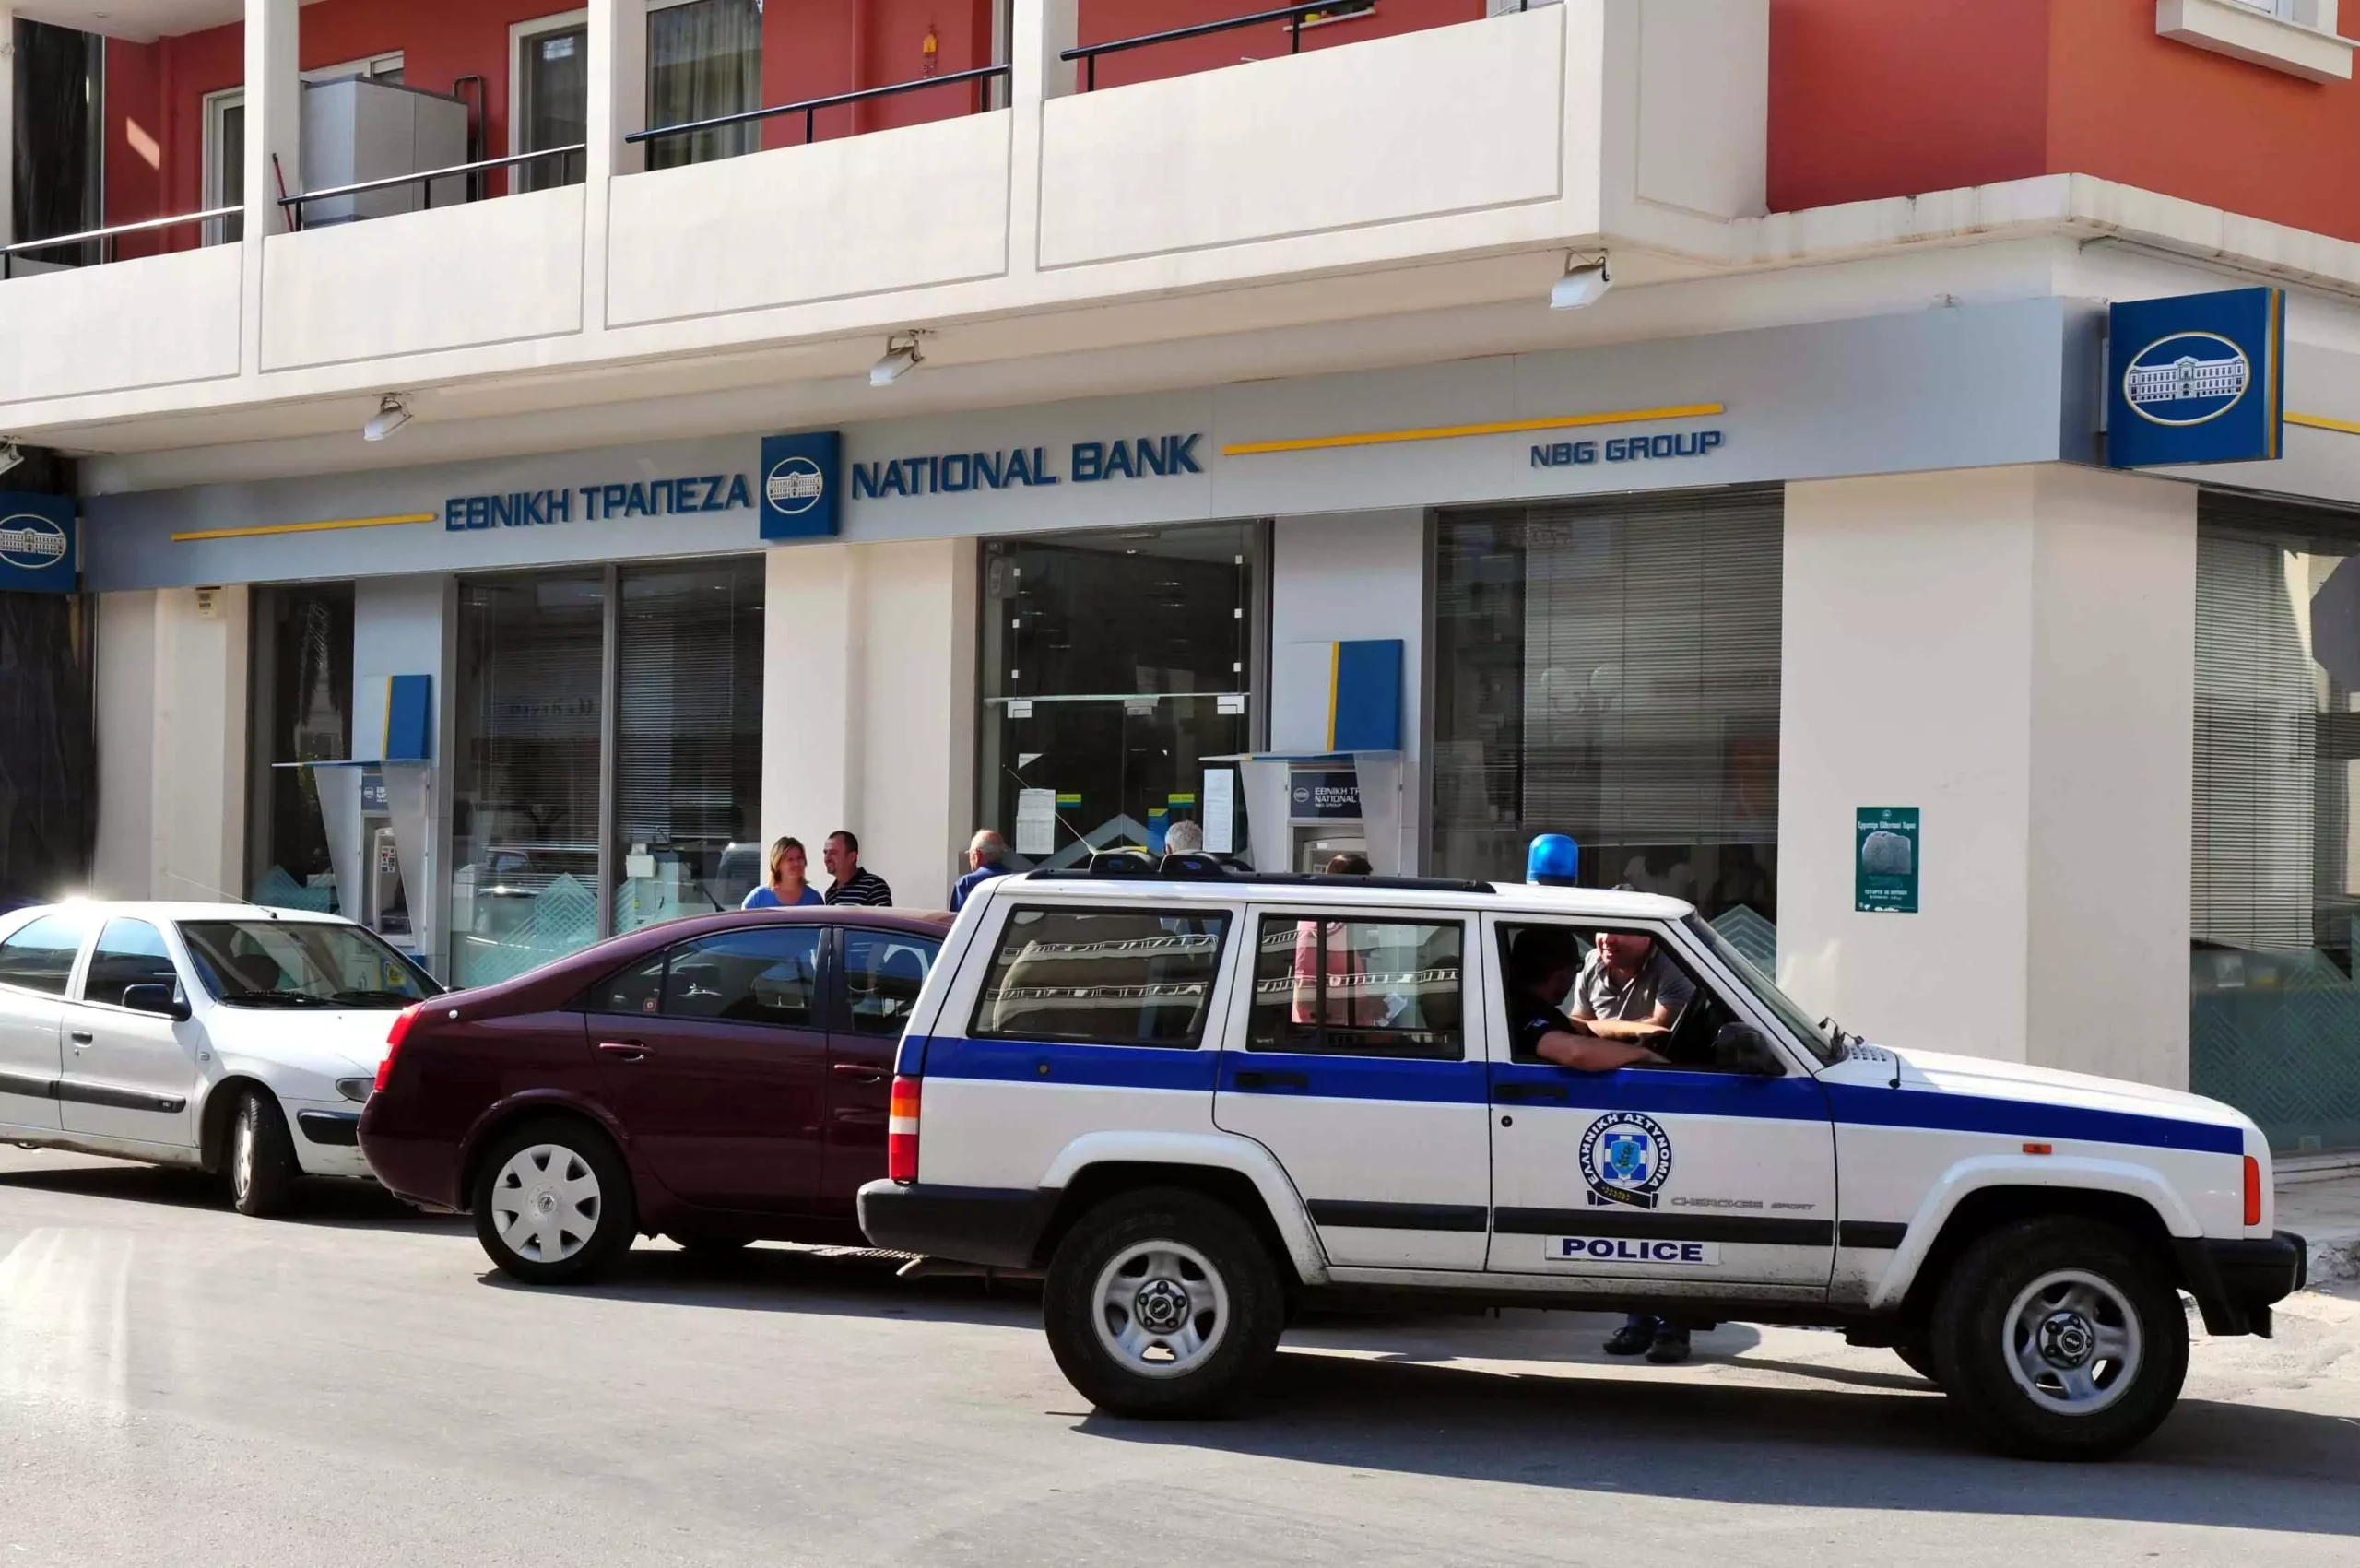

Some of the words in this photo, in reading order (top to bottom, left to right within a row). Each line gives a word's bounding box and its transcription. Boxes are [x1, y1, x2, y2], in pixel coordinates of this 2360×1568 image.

[851, 446, 1060, 501] NATIONAL
[1071, 432, 1203, 483] BANK
[1530, 441, 1596, 467] NBG
[1605, 430, 1722, 462] GROUP
[445, 488, 571, 532] ΕΘΝΙΚΗ
[579, 473, 753, 521] ΤΡΑΠΕΖΑ
[1581, 1114, 1619, 1185] ΕΛΛΗΝΙΚΗ
[1623, 1113, 1670, 1187] ΑΣΤΥΝΟΜΙΑ
[1670, 1197, 1764, 1209] CHEROKEE
[1770, 1201, 1816, 1210] SPORT
[1562, 1237, 1703, 1262] POLICE
